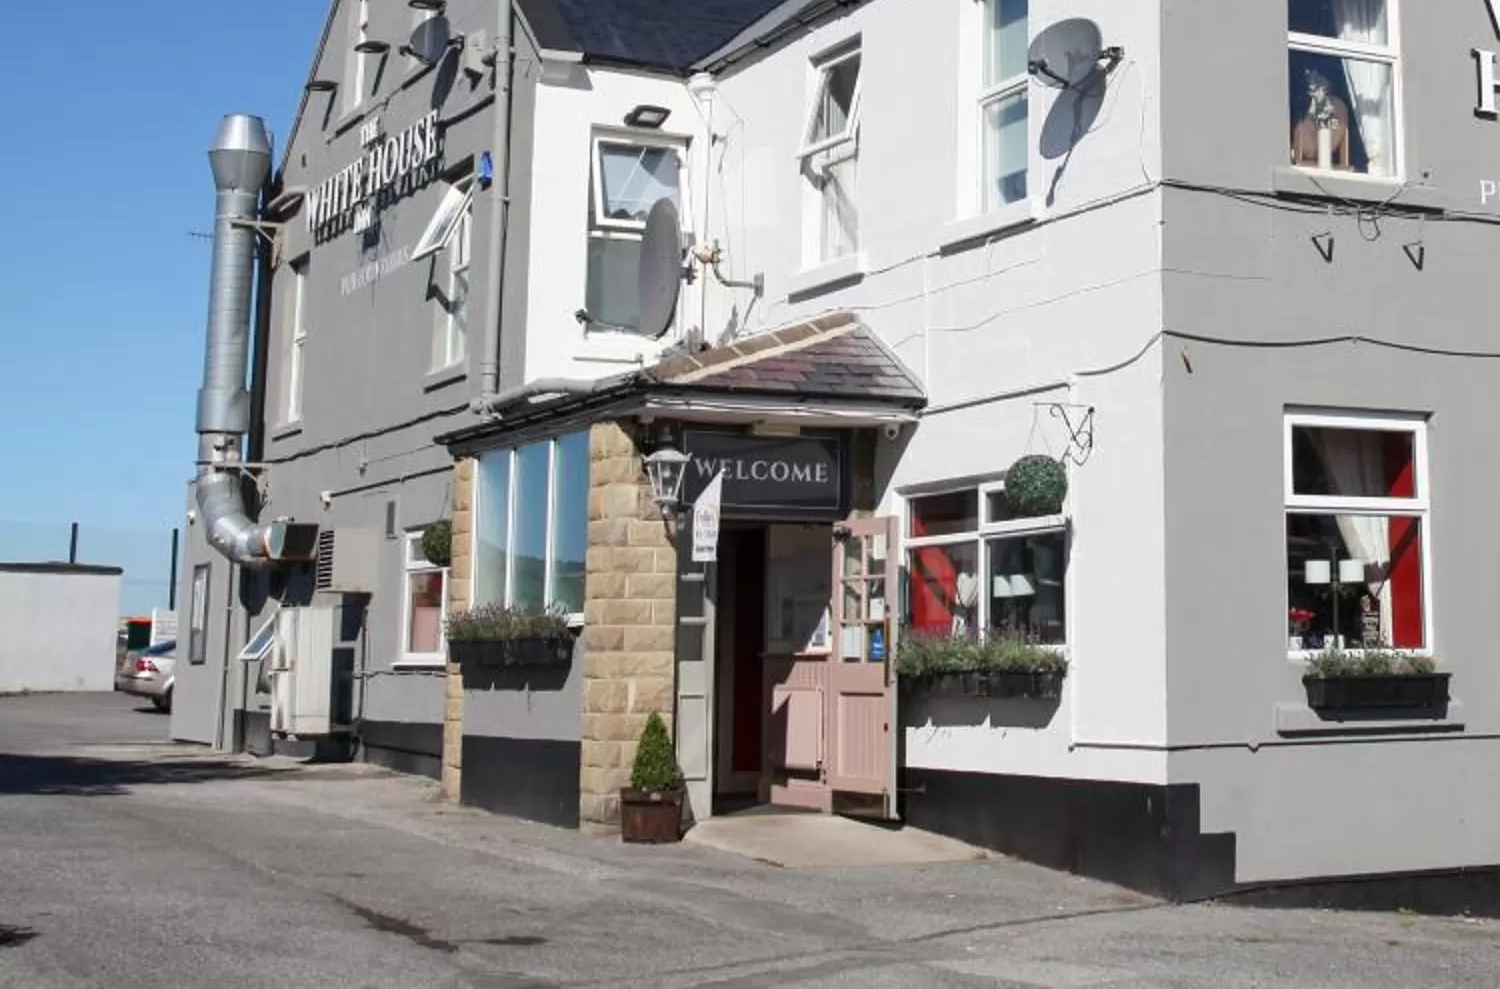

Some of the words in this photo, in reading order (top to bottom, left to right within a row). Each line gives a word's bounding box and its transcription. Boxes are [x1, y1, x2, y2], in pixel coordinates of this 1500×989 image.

[306, 157, 364, 233] WHITE
[367, 109, 438, 194] HOUSE
[693, 457, 830, 484] WELCOME
